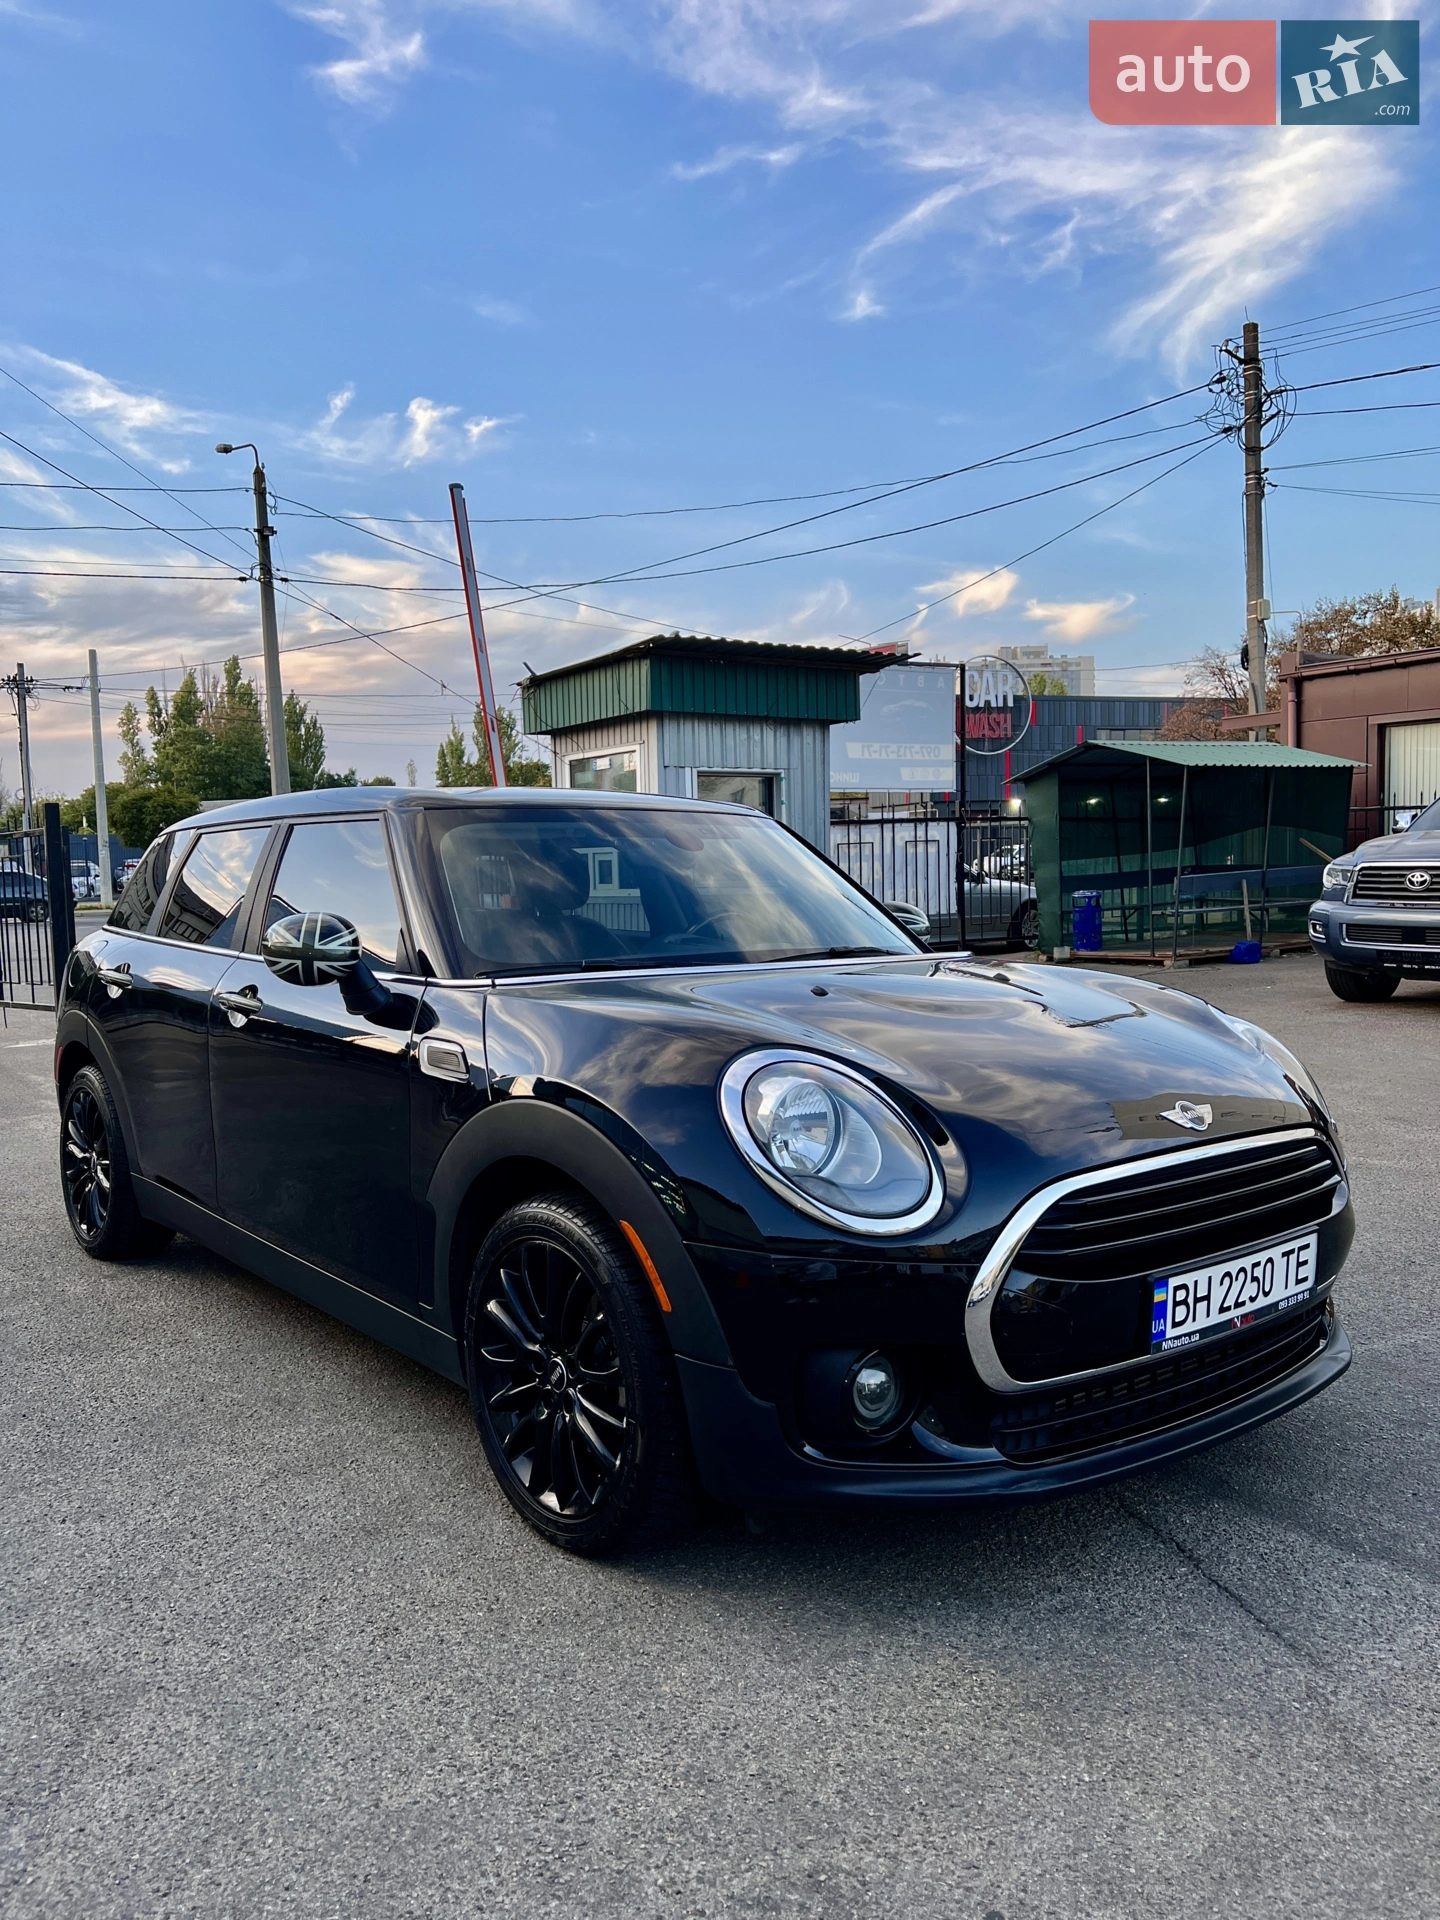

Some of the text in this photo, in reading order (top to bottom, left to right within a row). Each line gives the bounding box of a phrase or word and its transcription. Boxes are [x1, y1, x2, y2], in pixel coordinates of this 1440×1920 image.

[965, 669, 1014, 708] CAR
[965, 713, 1012, 738] WASH
[1171, 1242, 1311, 1329] BH 2250 TE
[1152, 1318, 1165, 1333] UA
[1161, 1333, 1200, 1351] NNauto.ua
